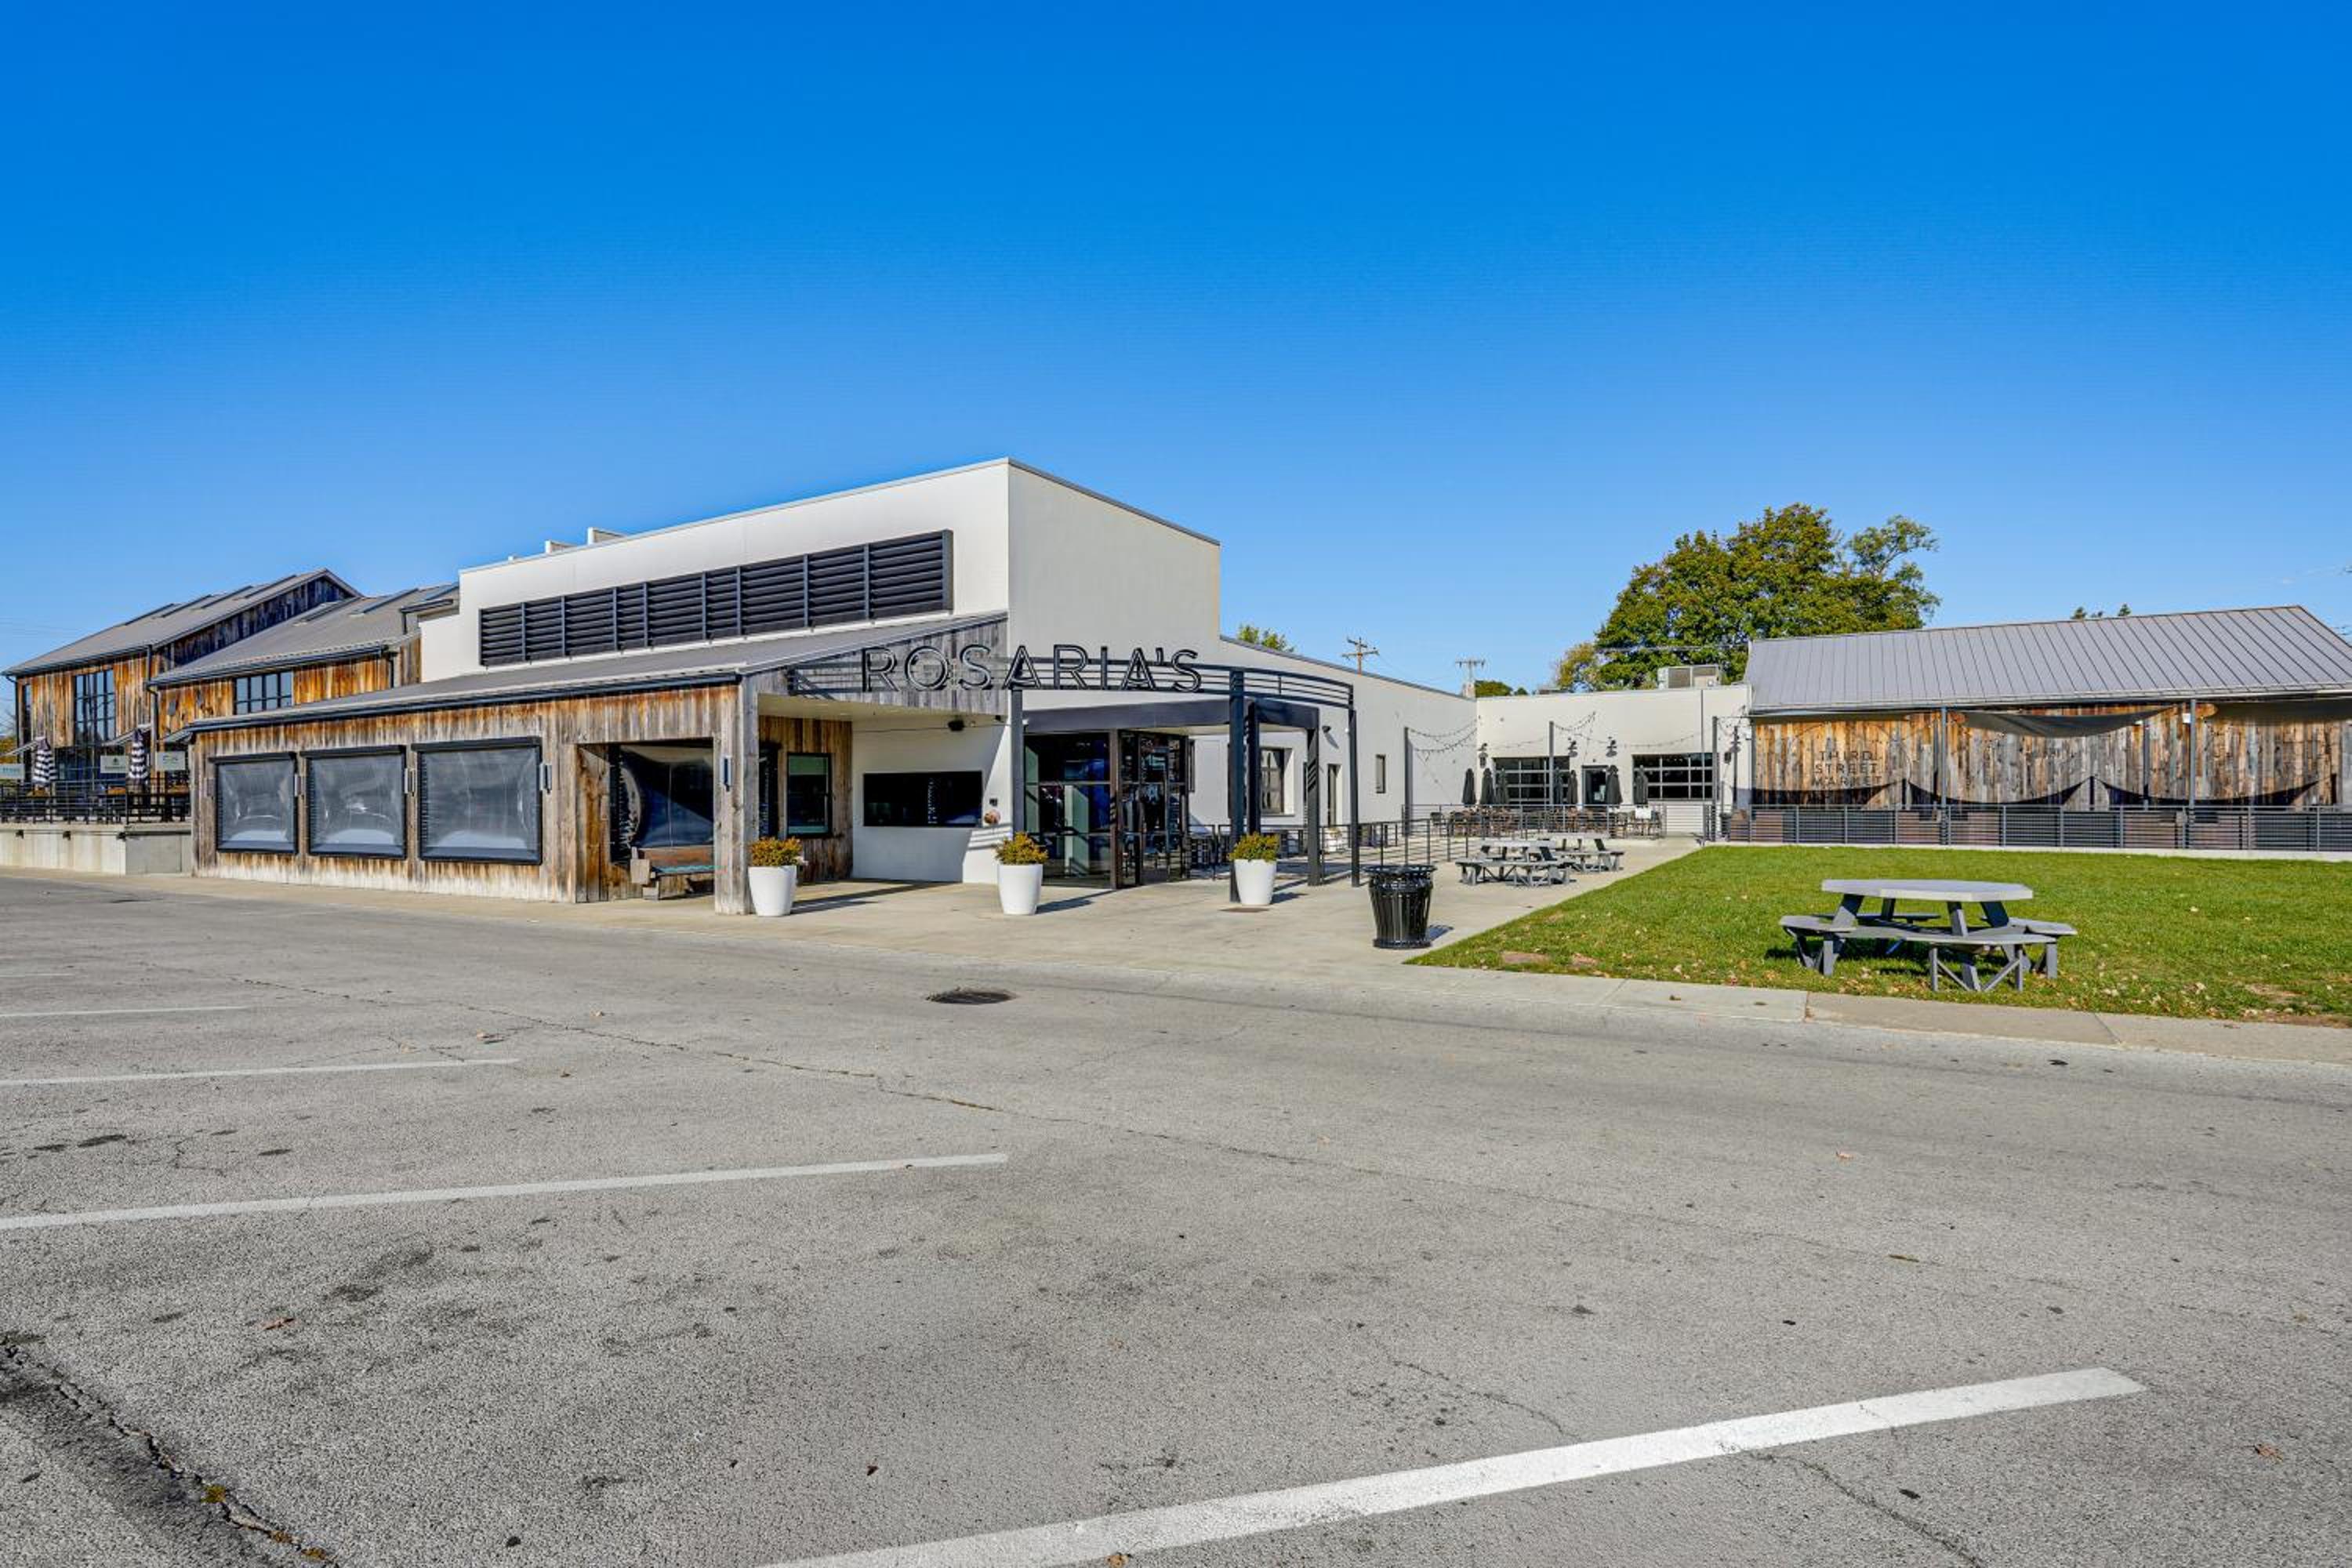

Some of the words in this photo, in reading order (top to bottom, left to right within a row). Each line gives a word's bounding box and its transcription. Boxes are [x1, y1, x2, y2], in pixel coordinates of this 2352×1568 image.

[862, 644, 1202, 693] ROSARIA'S
[1818, 750, 1873, 760] THIRD
[1814, 764, 1878, 774] STREET
[1811, 775, 1882, 787] MARKET
